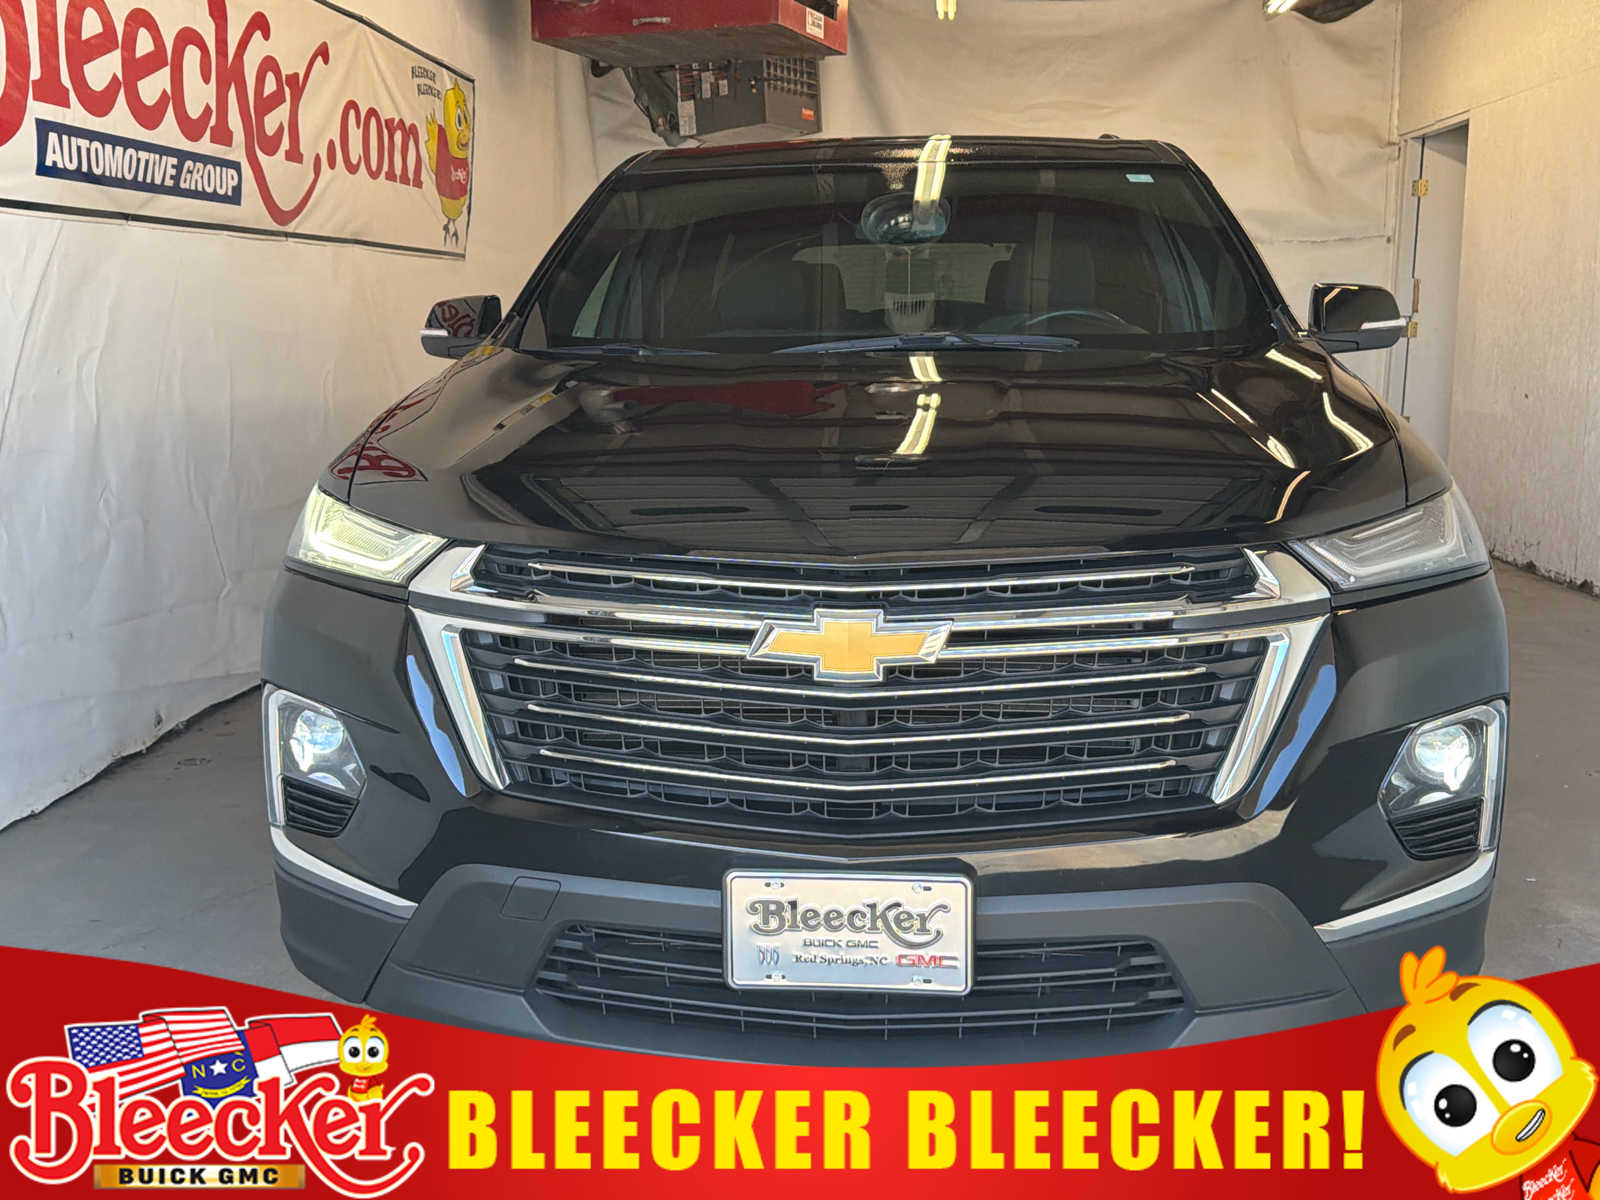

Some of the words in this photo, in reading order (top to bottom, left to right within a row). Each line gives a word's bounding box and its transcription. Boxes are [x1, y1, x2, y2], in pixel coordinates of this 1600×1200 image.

[0, 0, 423, 226] leecker.com
[45, 132, 177, 186] AUTOMOTIVE
[180, 160, 239, 197] GROUP
[746, 897, 950, 950] Bleecker
[794, 954, 818, 965] Red
[803, 938, 842, 948] BUICK
[846, 939, 879, 949] GMC
[897, 954, 960, 970] GMC
